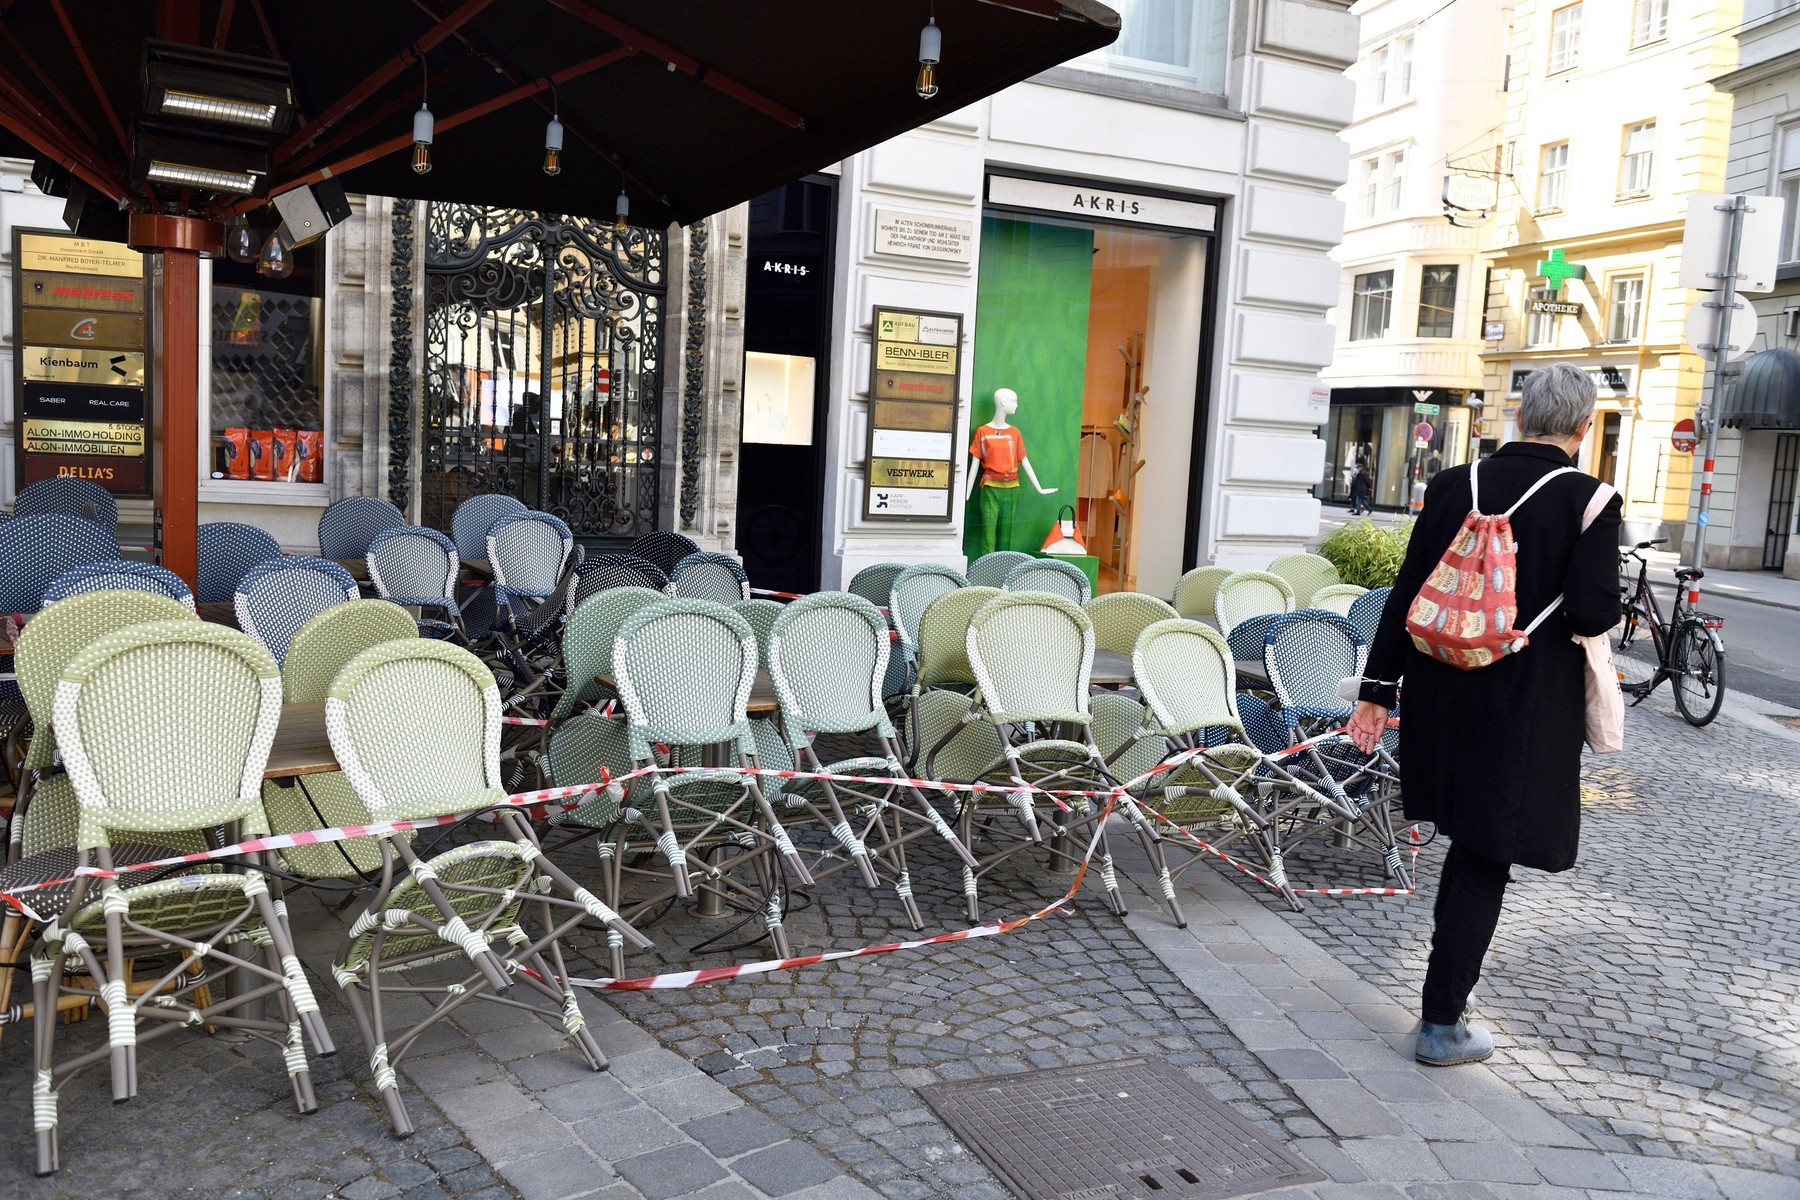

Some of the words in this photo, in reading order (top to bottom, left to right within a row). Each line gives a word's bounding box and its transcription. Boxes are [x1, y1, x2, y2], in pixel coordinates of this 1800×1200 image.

[50, 255, 79, 264] MANFRED
[80, 258, 126, 267] BOYER-TELMER
[53, 286, 134, 301] madress
[1532, 302, 1579, 313] APOTHEKE
[885, 346, 949, 360] BENN-IBLER
[40, 356, 98, 369] Kienbaum
[39, 396, 66, 404] SABER
[89, 399, 108, 407] REAL
[109, 400, 130, 408] CARE
[27, 428, 91, 438] ALON-IMMO
[92, 431, 141, 441] HOLDING
[27, 442, 125, 454] ALON-IMMOBILIEN
[59, 466, 114, 479] DELIA'S
[887, 468, 934, 479] VESTWERK
[1443, 573, 1455, 588] SOUP
[1422, 607, 1434, 622] SOUP
